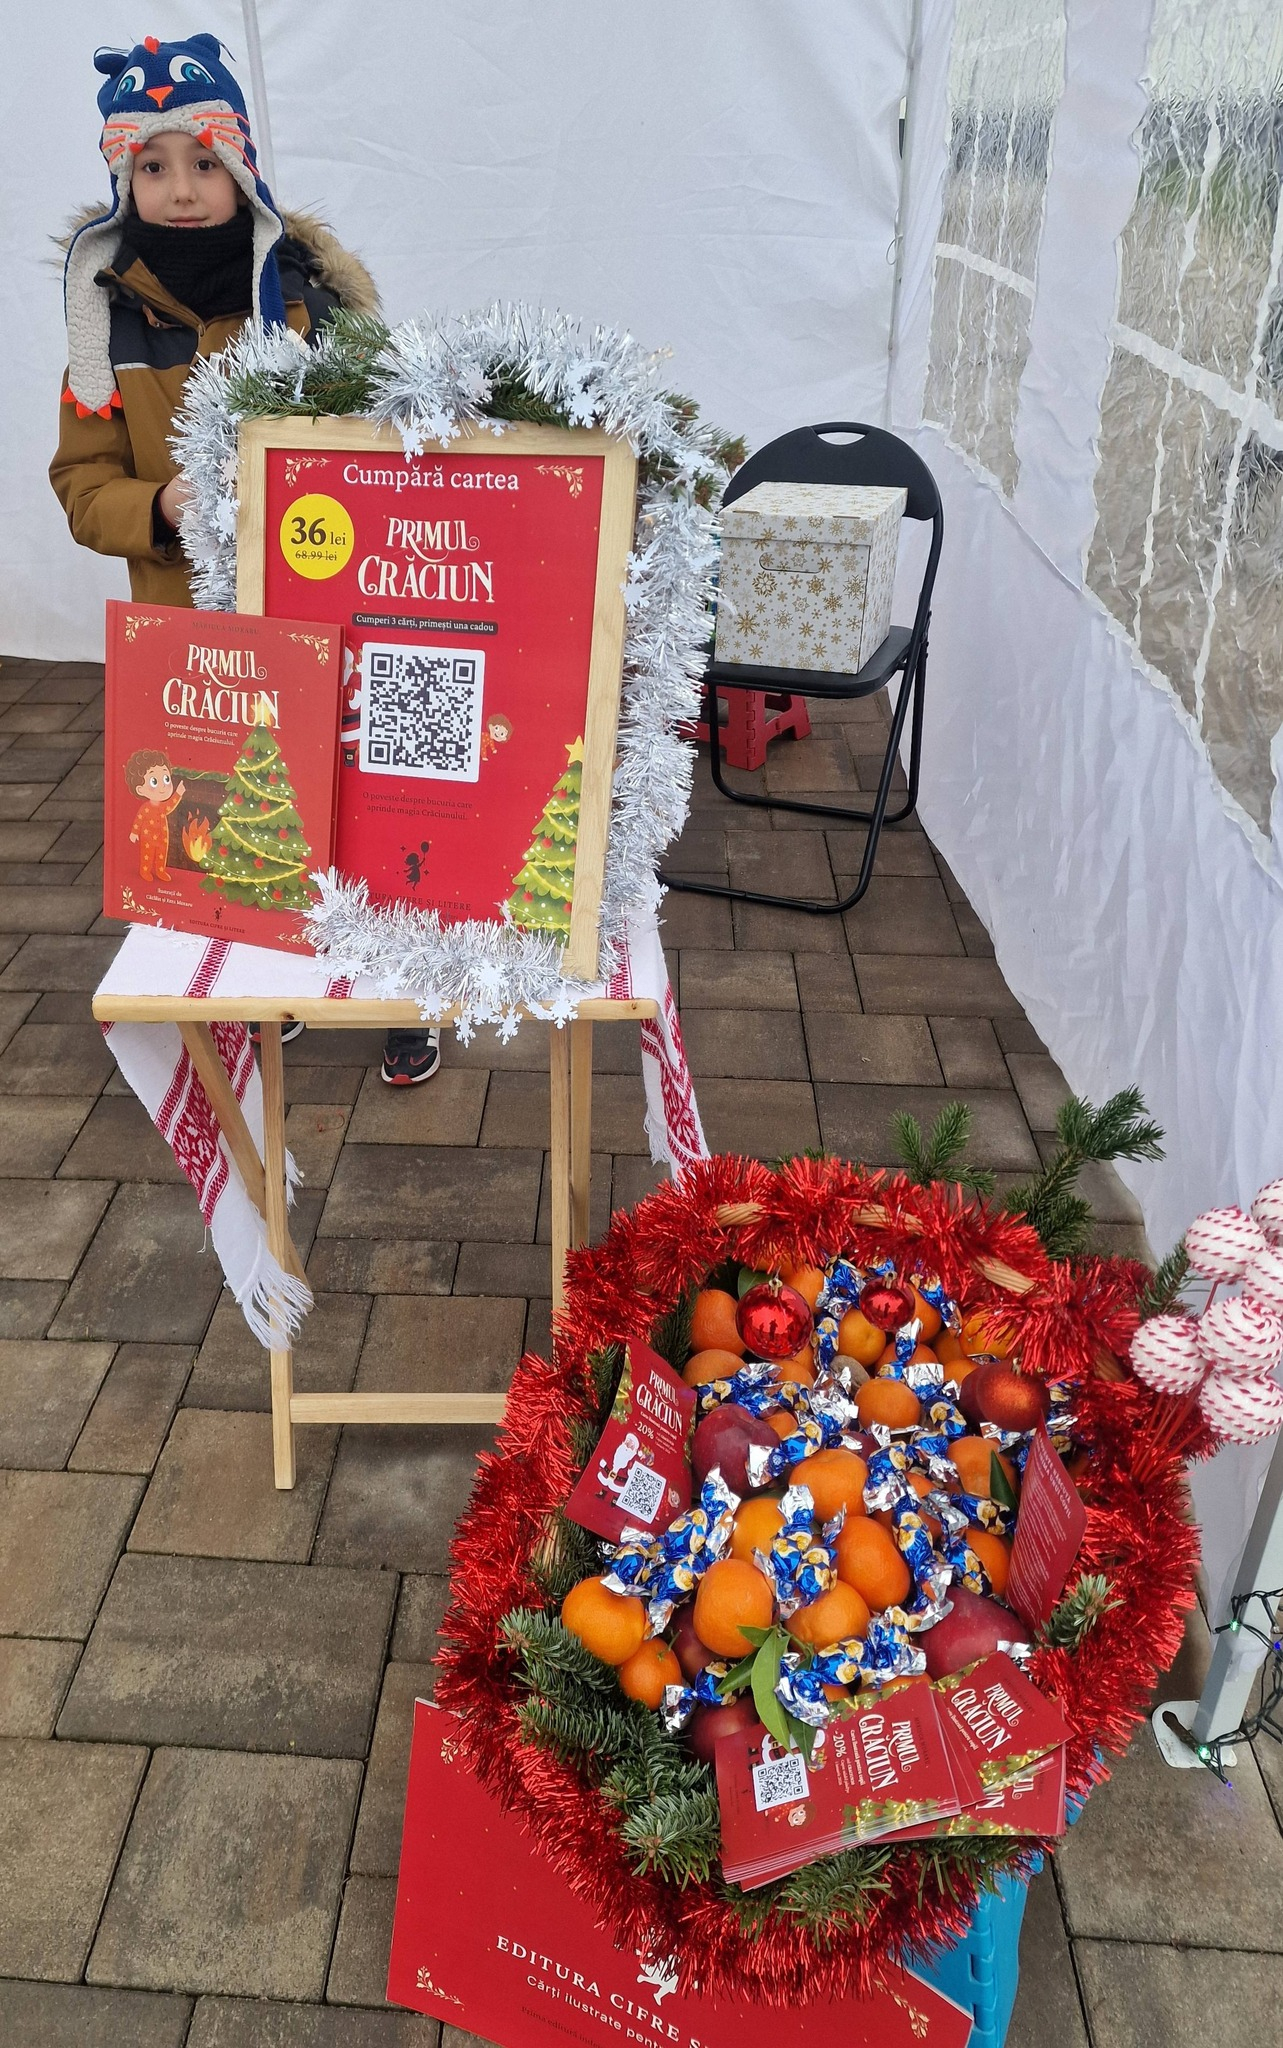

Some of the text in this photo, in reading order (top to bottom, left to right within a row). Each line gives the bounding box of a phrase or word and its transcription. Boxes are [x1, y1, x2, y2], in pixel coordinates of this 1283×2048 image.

[343, 464, 520, 493] Cumpără cartea
[291, 516, 347, 546] 36 lei
[386, 517, 480, 562] PRIMUL
[295, 550, 338, 561] 68.99 lei
[357, 554, 495, 603] CRĂCIUN
[356, 614, 390, 625] Cumperi
[391, 617, 397, 625] 3
[453, 622, 469, 631] una
[470, 622, 494, 632] cadou
[185, 643, 267, 689] PRIMUL
[162, 677, 281, 729] CRĂCIUN
[362, 791, 370, 799] O
[370, 792, 401, 801] poveste
[400, 794, 425, 805] despre
[426, 797, 456, 807] bucuria
[367, 804, 397, 814] aprinde
[397, 807, 420, 817] magia
[438, 900, 471, 911] LITERE
[636, 1383, 683, 1437] CRĂCIUN
[649, 1369, 680, 1407] PRIMUL
[950, 1688, 1012, 1754] CRĂCIUN
[983, 1682, 1024, 1727] PRIMUL
[833, 1730, 847, 1758] -20%
[858, 1713, 899, 1792] CRĂCIUN
[888, 1720, 921, 1773] PRIMUL
[496, 1935, 680, 2042] EDITURA CIFRE
[526, 1975, 561, 1999] Cărți
[564, 1991, 622, 2031] ilustrate
[626, 2027, 662, 2048] pent
